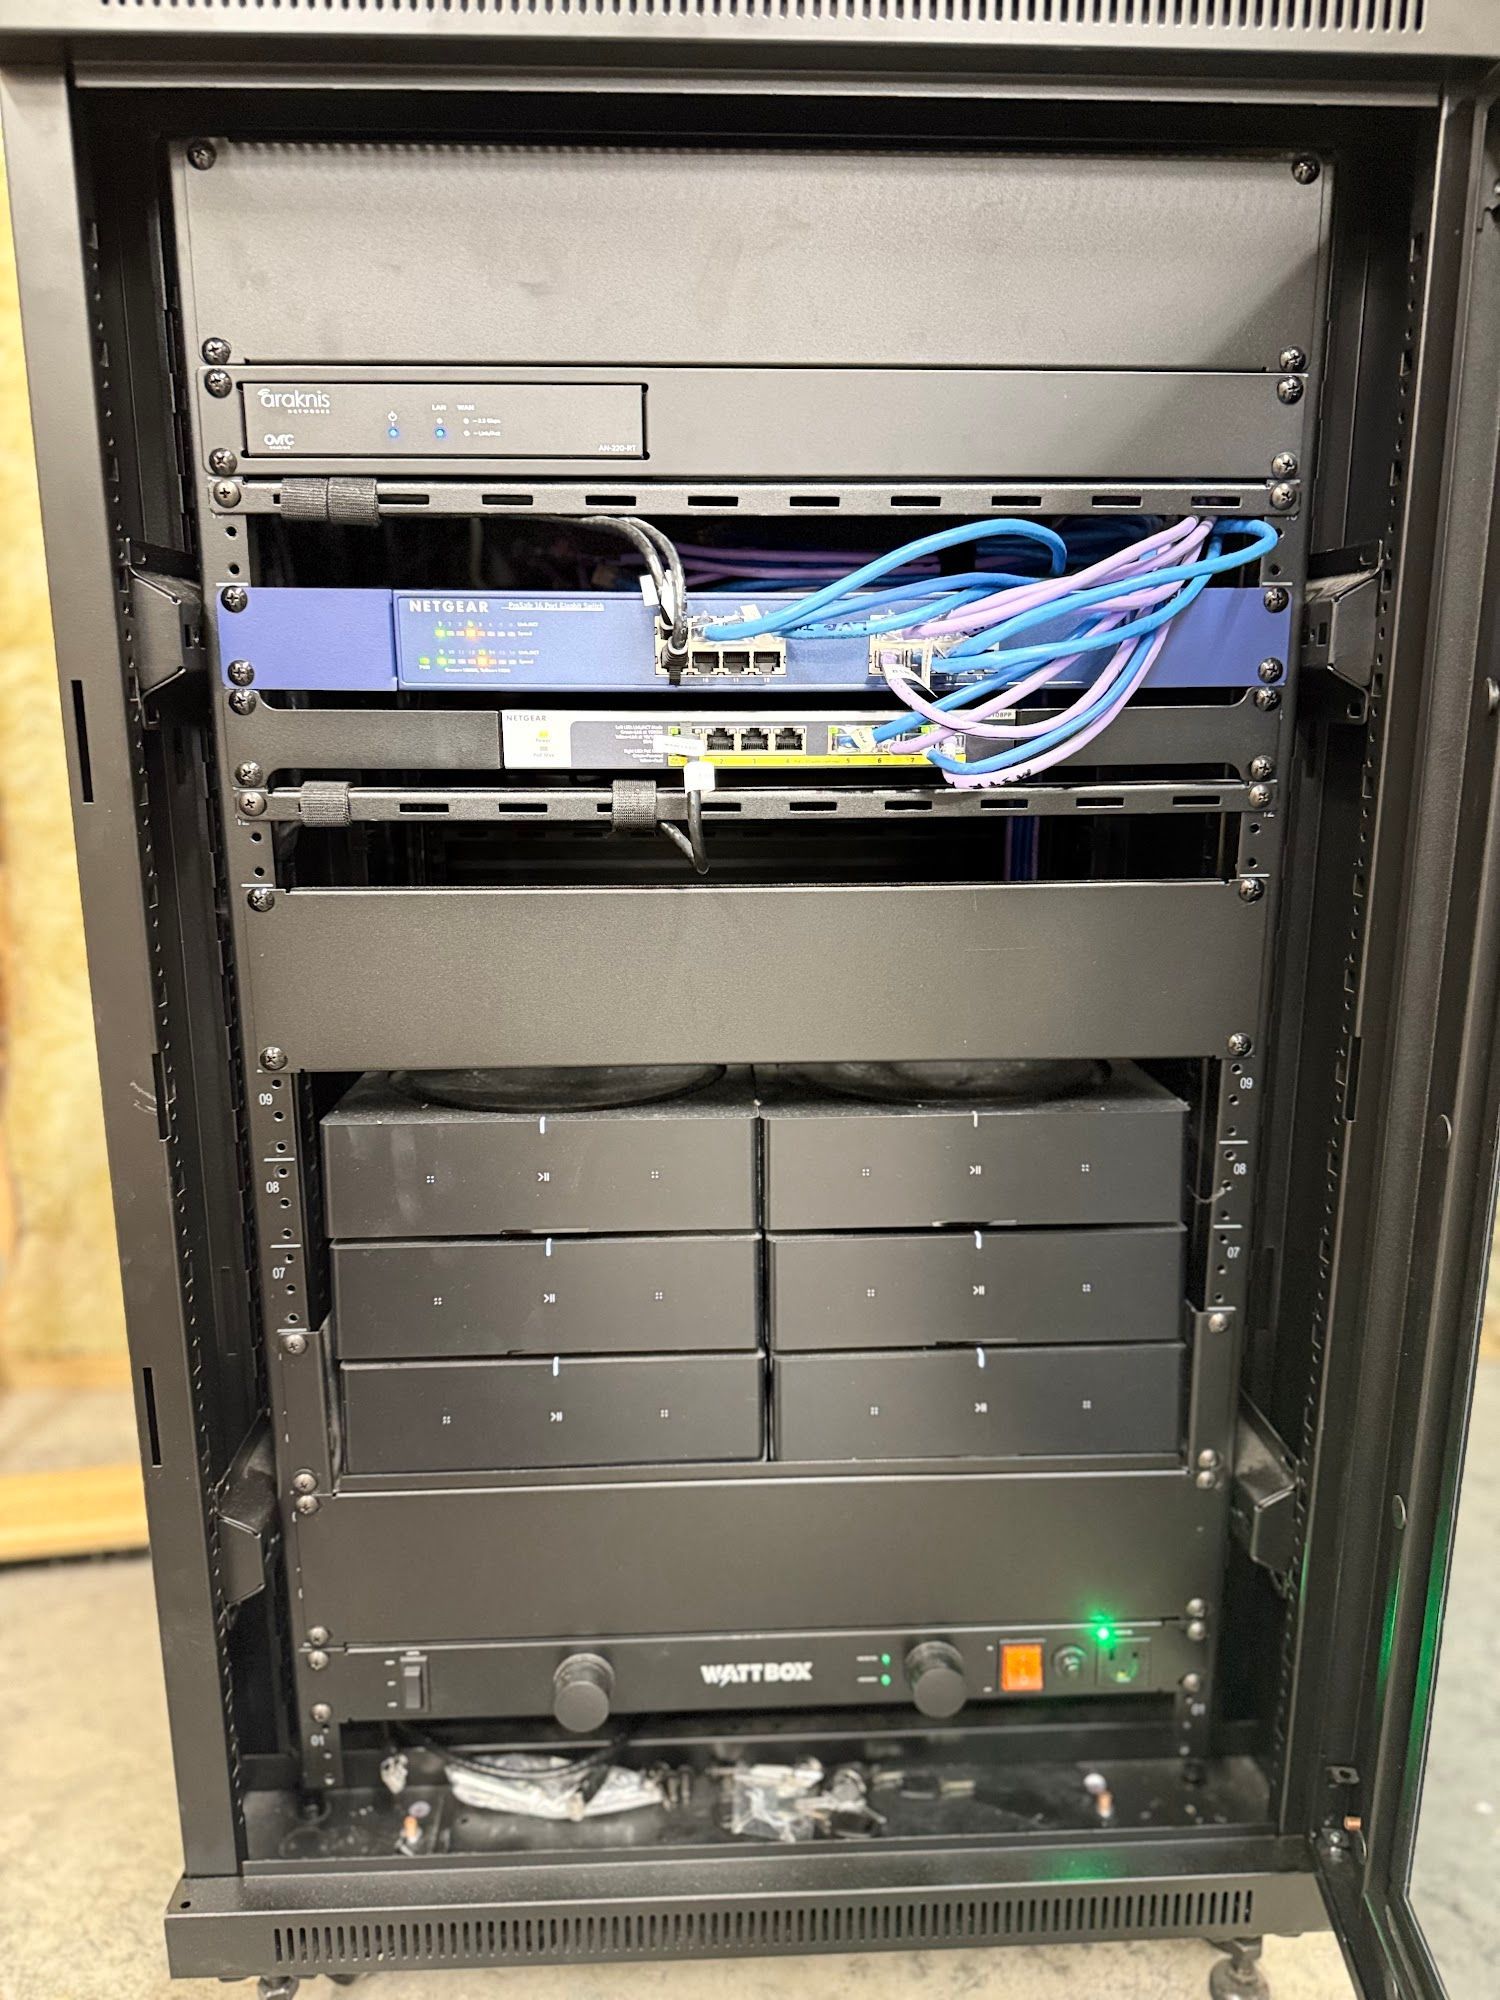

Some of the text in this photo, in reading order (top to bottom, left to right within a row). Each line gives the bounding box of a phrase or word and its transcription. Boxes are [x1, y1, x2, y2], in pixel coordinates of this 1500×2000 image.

[258, 389, 331, 408] araknis
[598, 444, 637, 452] AN-220-RT
[409, 600, 489, 613] NETGEAR
[1240, 1077, 1253, 1089] 09
[259, 1093, 273, 1105] 09
[1233, 1163, 1247, 1175] 08
[266, 1181, 280, 1194] 08
[1227, 1247, 1240, 1258] 07
[272, 1267, 286, 1279] 07
[700, 1662, 813, 1687] WATTBOX
[310, 1734, 325, 1746] 01
